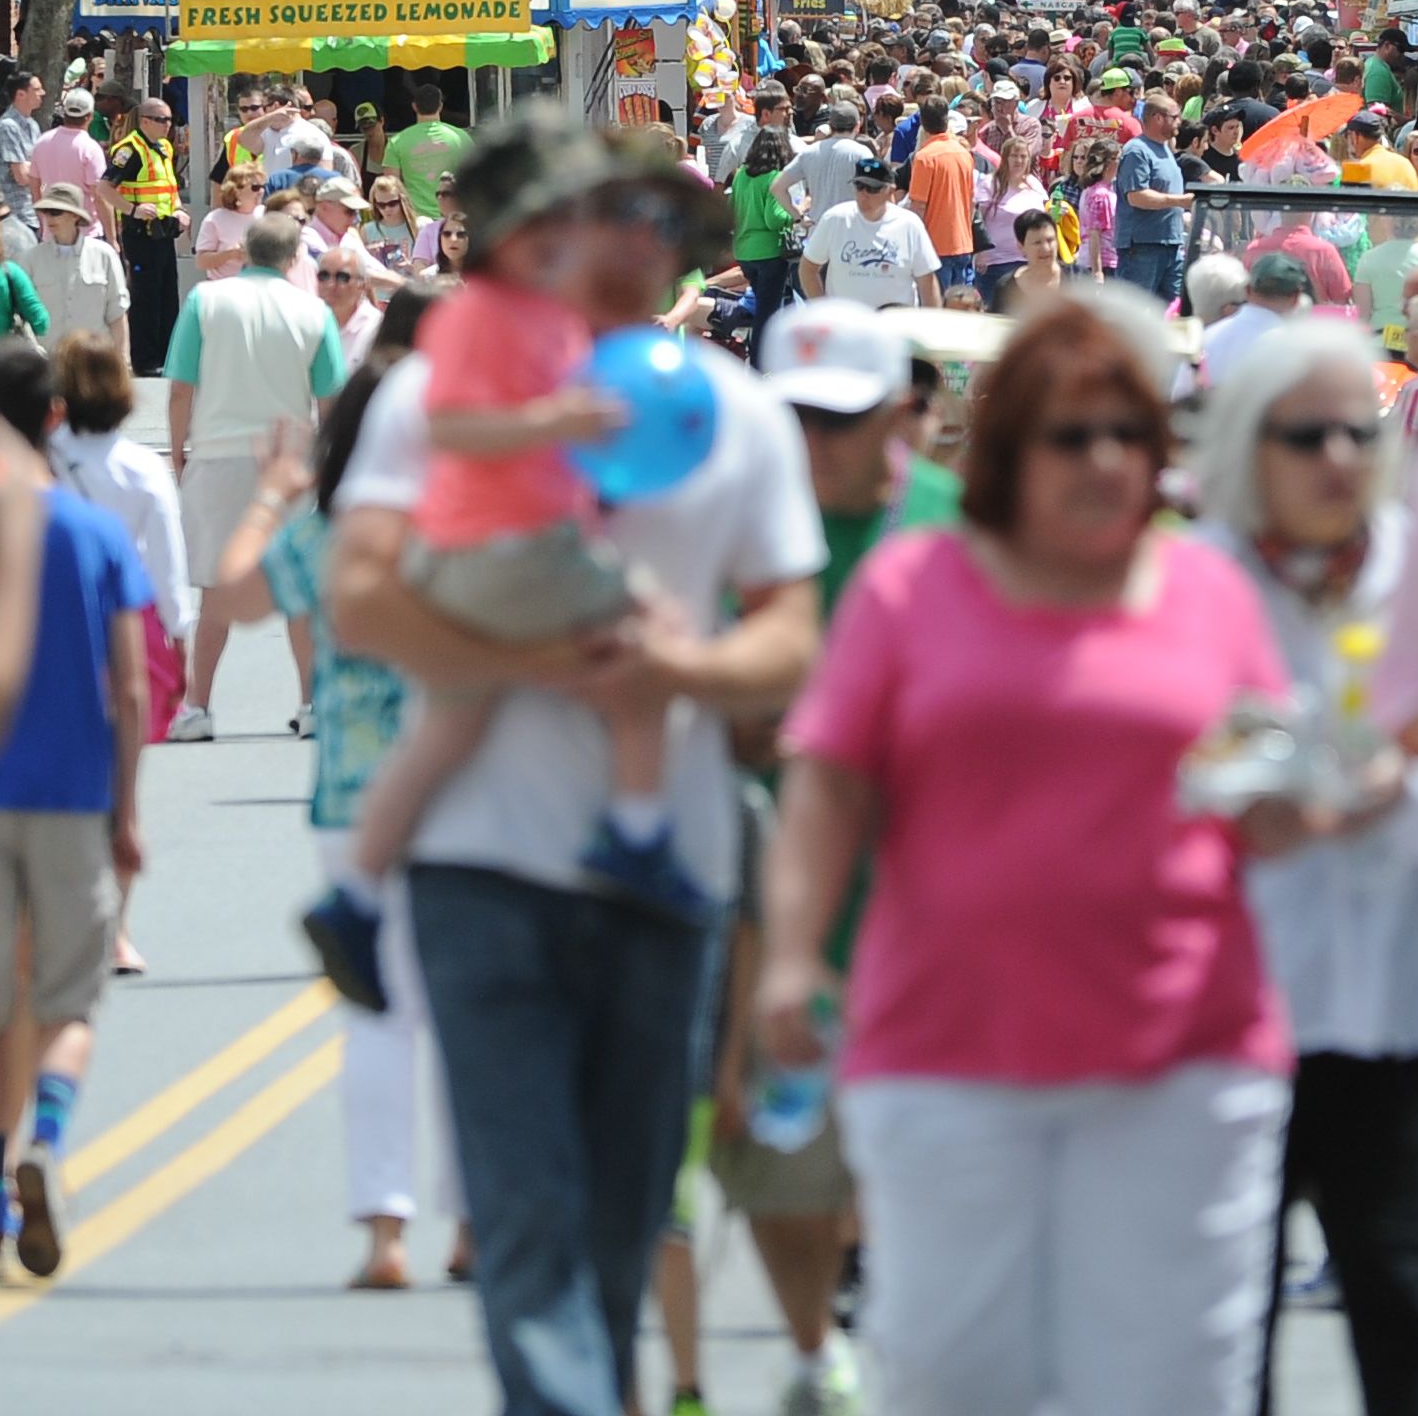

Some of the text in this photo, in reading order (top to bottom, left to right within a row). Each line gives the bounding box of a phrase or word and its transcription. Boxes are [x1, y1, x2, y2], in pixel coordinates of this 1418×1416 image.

[187, 0, 521, 27] FRESH SQUEEZED LEMONADE
